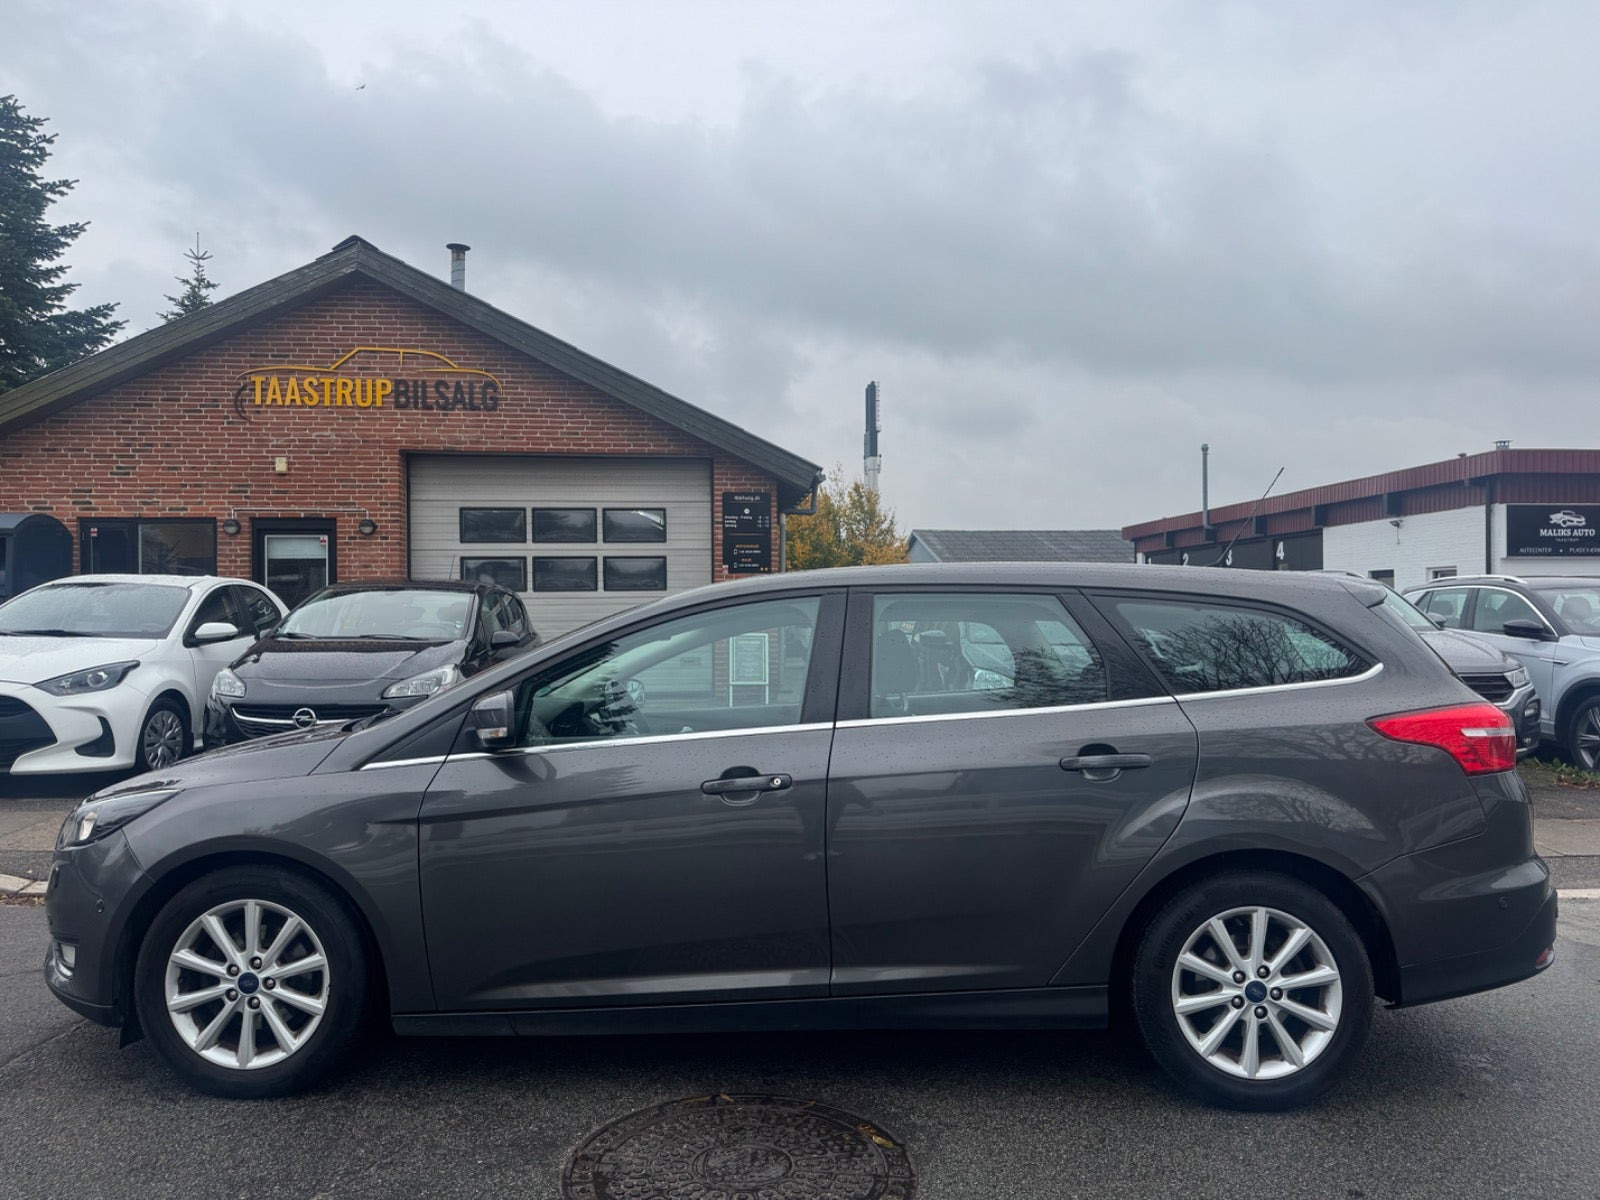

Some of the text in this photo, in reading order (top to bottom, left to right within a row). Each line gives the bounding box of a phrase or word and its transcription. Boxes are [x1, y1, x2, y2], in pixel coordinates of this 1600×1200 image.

[1539, 528, 1596, 537] MALIKS AUTO
[1276, 541, 1285, 560] 4
[1183, 553, 1189, 565] 2
[1226, 550, 1232, 565] 3
